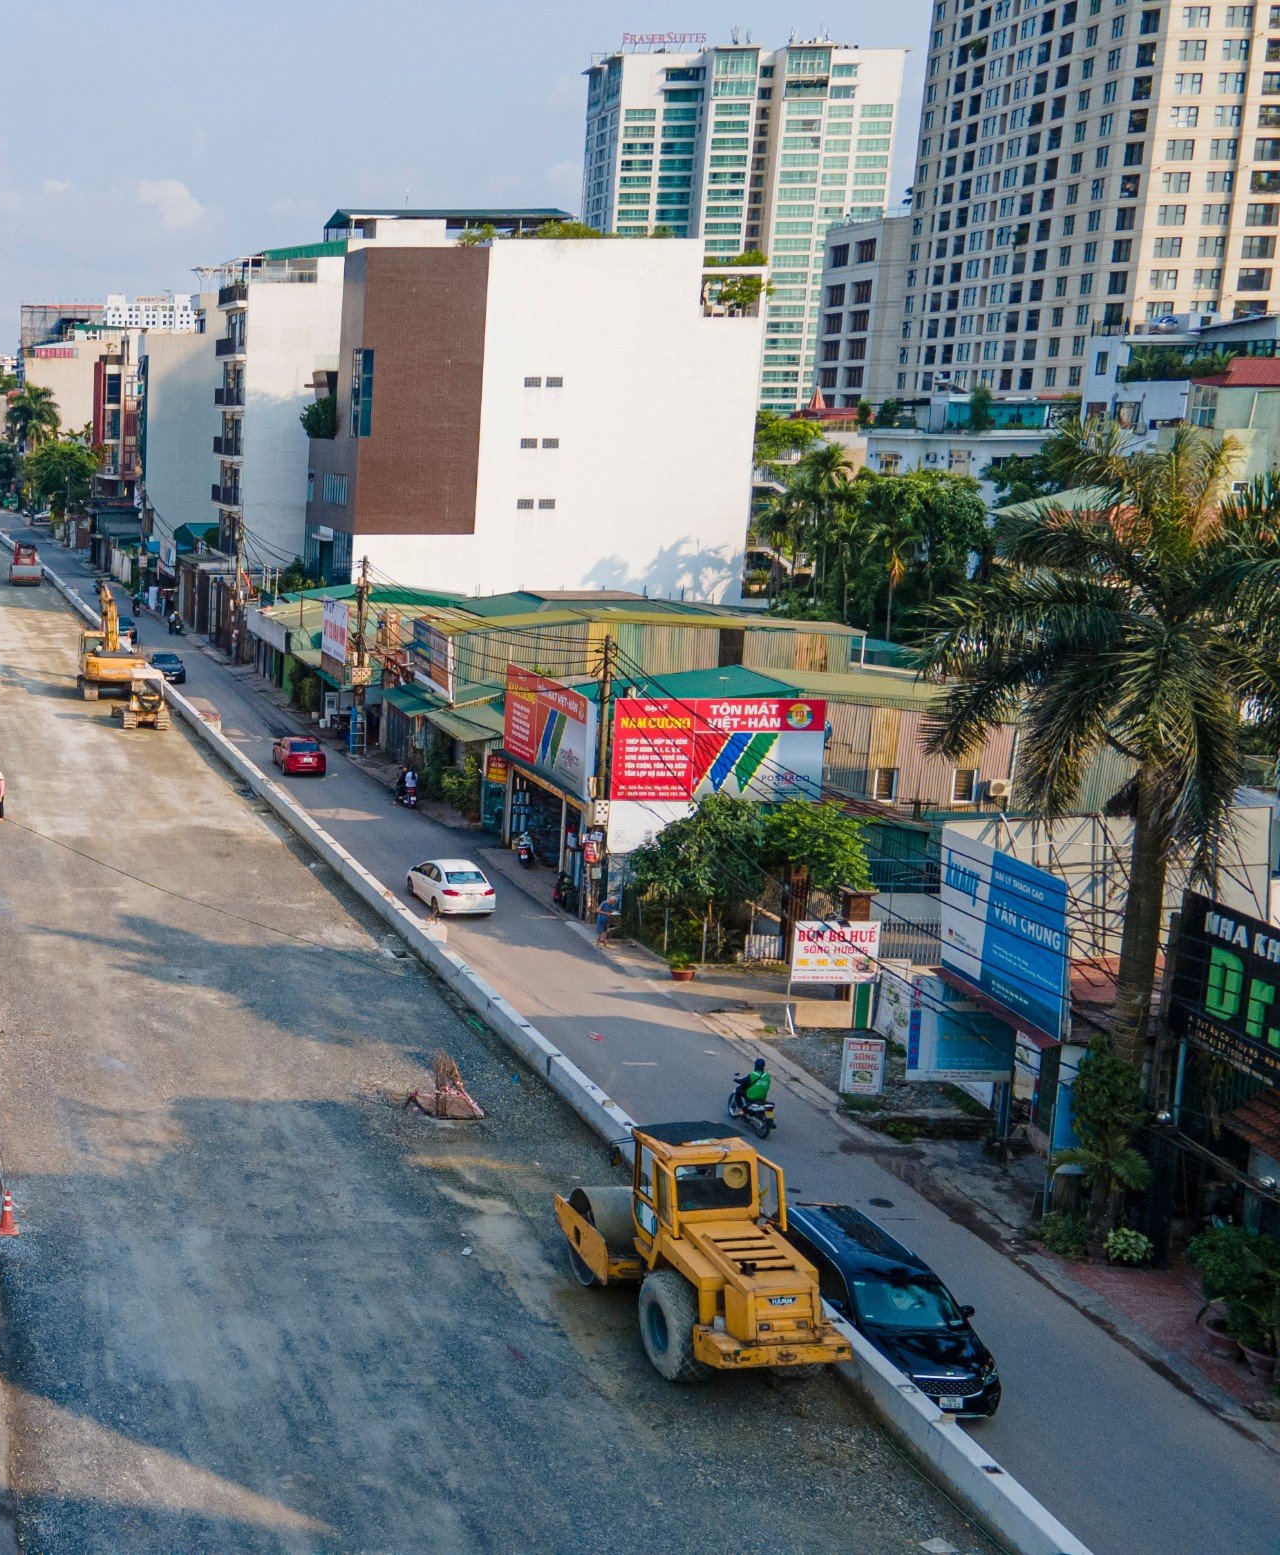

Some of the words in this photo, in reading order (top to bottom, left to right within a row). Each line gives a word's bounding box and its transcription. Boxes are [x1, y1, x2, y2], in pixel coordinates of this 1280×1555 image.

[710, 702, 742, 715] TÔN
[744, 702, 779, 715] MÁT
[621, 717, 647, 729] NAM
[798, 926, 824, 942] BÚN
[850, 925, 877, 942] HUẾ
[1021, 915, 1061, 951] CHUNG
